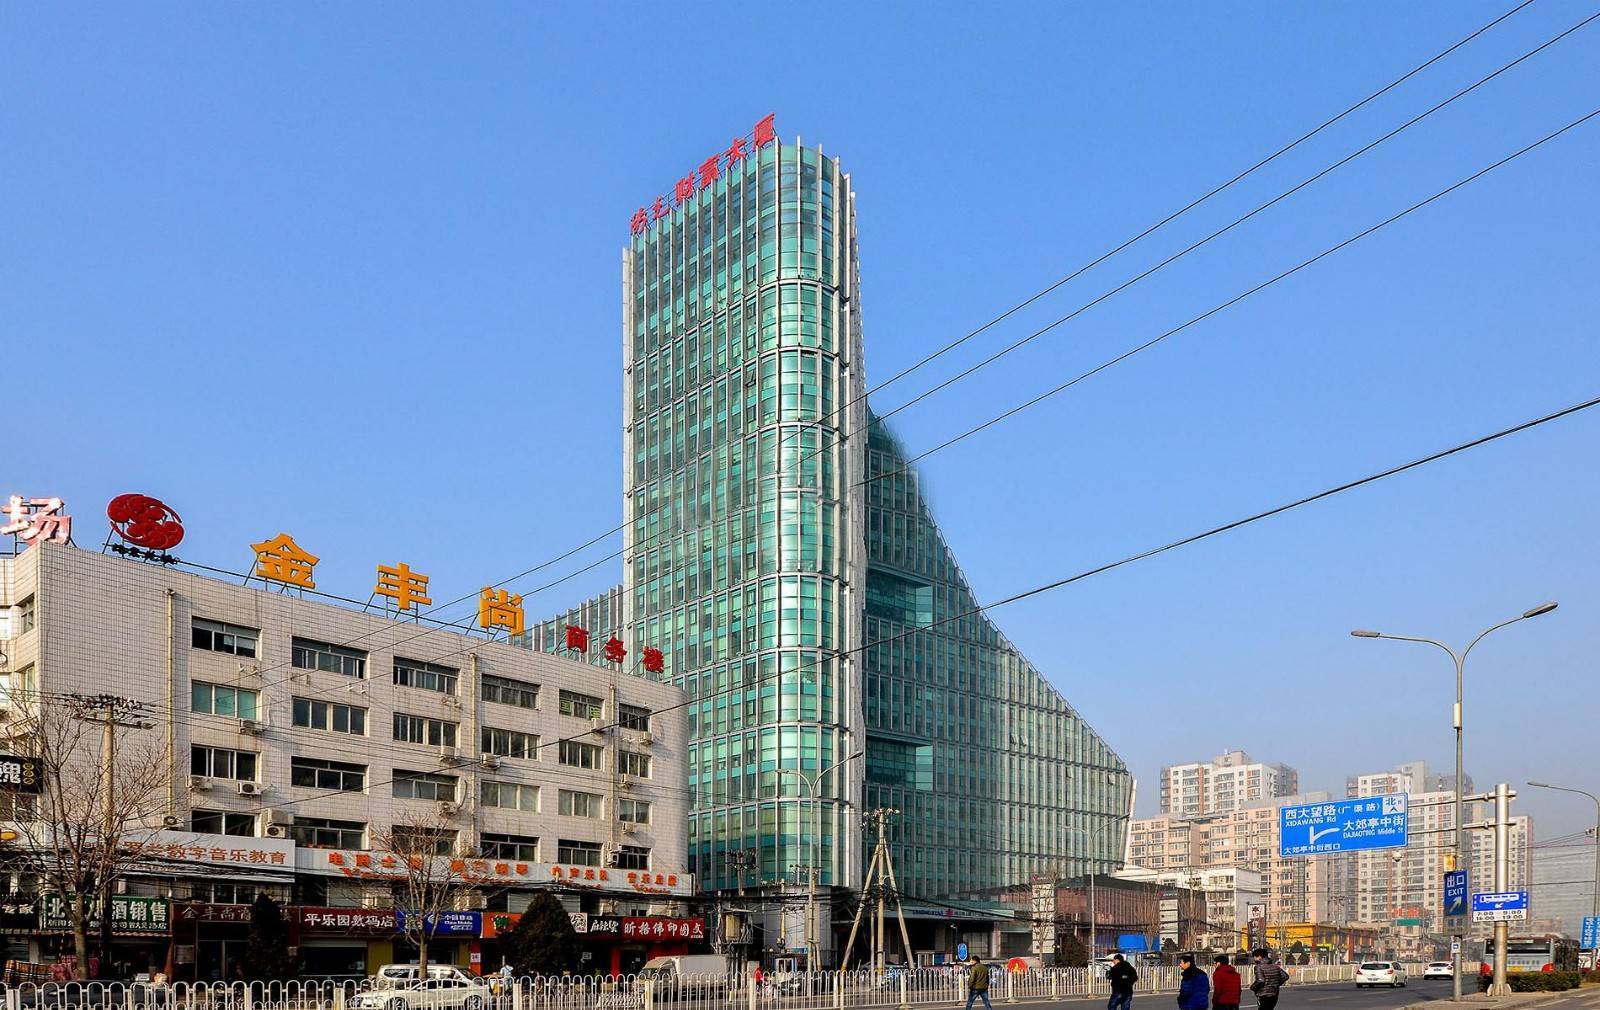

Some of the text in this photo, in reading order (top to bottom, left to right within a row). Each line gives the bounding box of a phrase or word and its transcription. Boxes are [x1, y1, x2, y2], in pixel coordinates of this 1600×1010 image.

[1285, 804, 1336, 819] 西大望路
[1286, 818, 1324, 827] XIDAWANG
[1343, 815, 1404, 831] 大郊亭中街
[1343, 829, 1375, 839] DAJIAOTING
[1447, 875, 1465, 888] 出口
[1447, 888, 1464, 897] EXIT
[48, 897, 167, 922] 北酒销售
[181, 905, 293, 922] 金丰尚商楼
